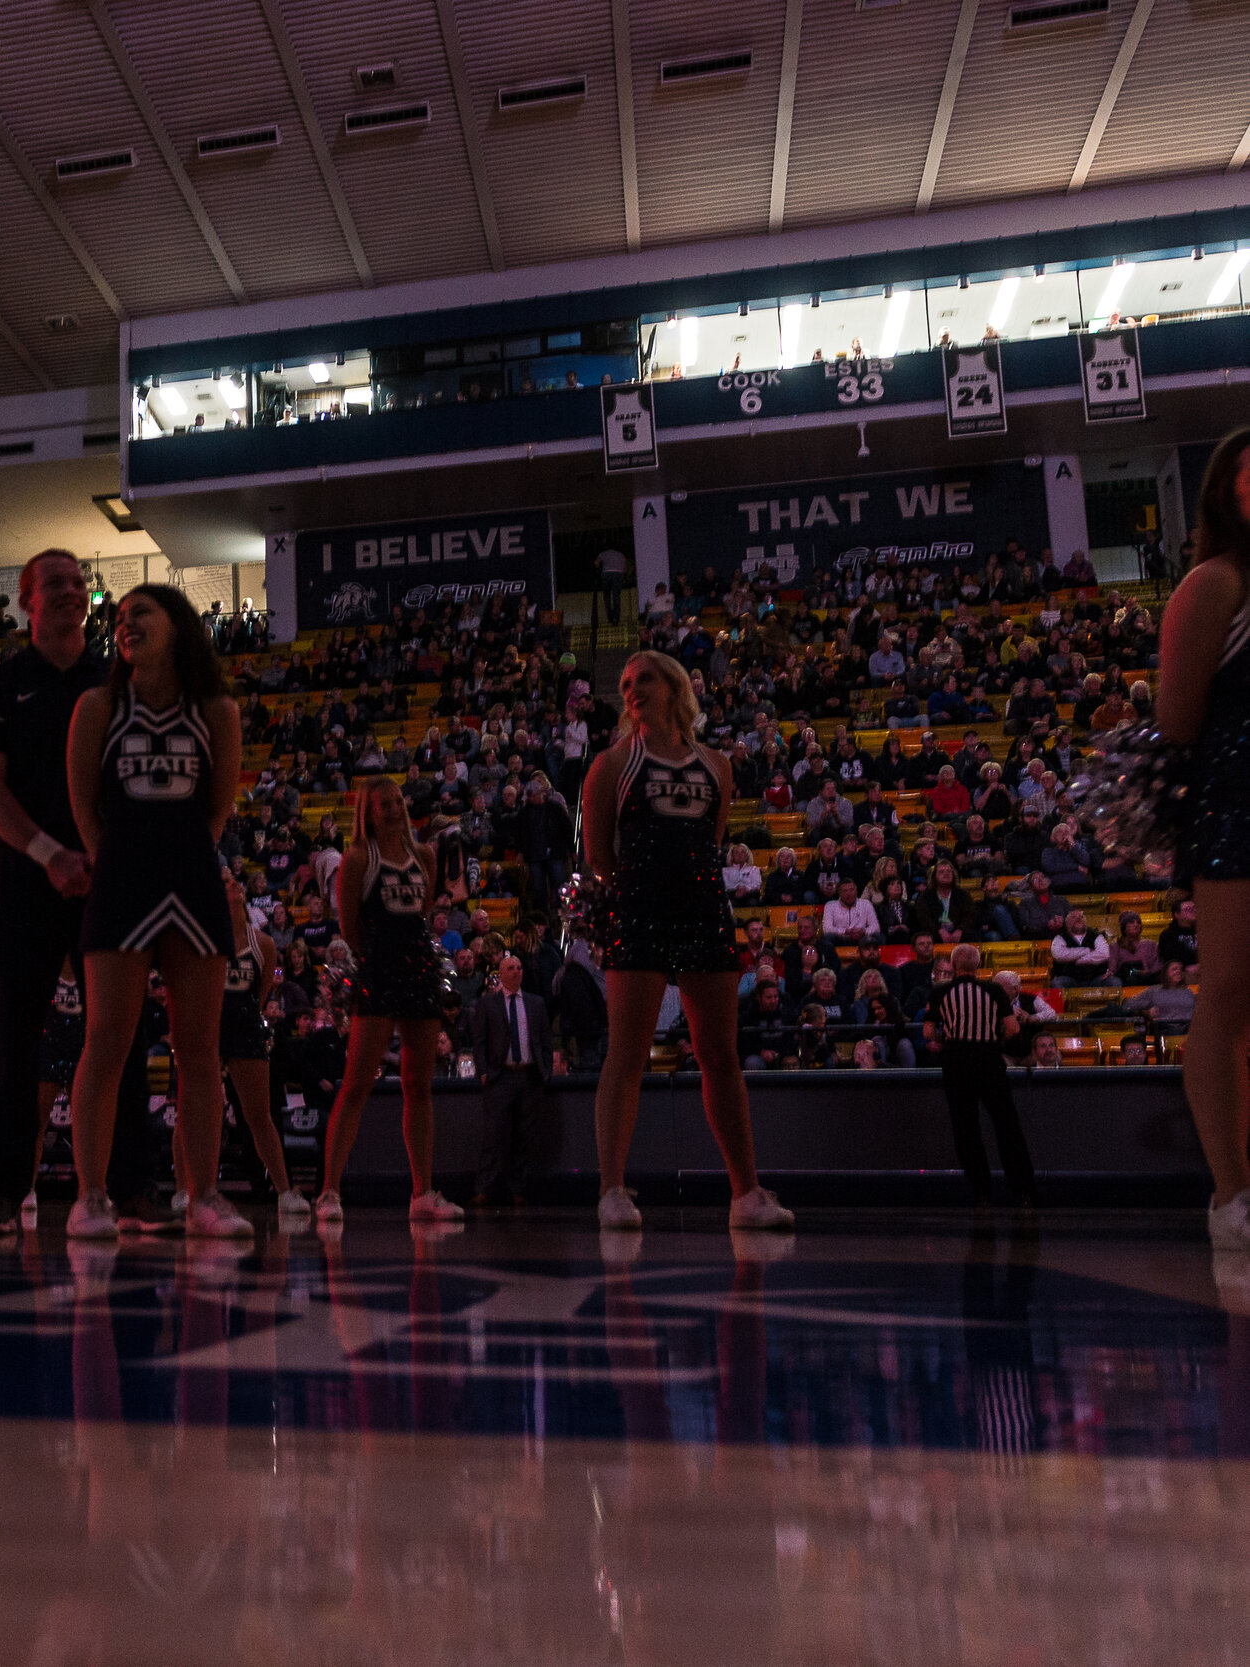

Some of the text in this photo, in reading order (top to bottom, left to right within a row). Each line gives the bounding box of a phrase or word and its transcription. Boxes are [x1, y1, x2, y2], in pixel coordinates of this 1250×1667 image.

[718, 370, 781, 392] COOK
[837, 373, 885, 404] 33
[1096, 369, 1129, 391] 31
[740, 386, 763, 415] 6
[957, 384, 993, 407] 24
[622, 424, 637, 441] 5
[1056, 461, 1072, 479] A
[642, 502, 658, 520] A
[738, 480, 974, 534] THAT WE
[274, 536, 286, 553] X
[322, 524, 526, 574] I BELIEVE
[929, 541, 974, 560] Pro
[487, 579, 527, 598] Pro
[117, 754, 200, 780] STATE
[645, 781, 713, 801] STATE
[228, 968, 254, 981] ATE
